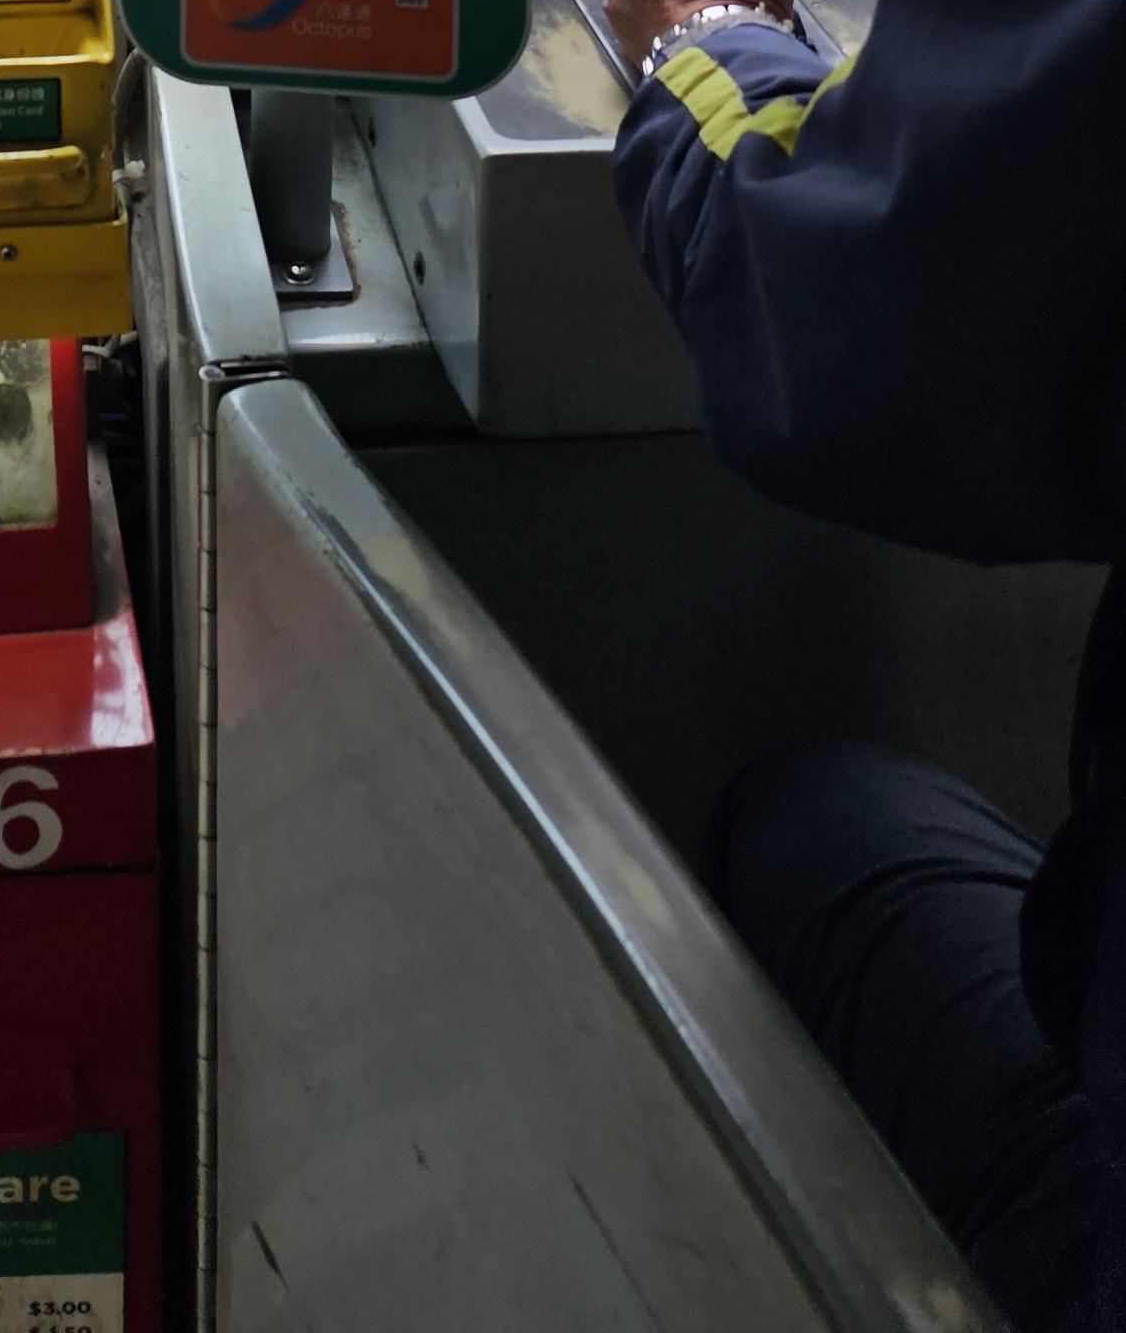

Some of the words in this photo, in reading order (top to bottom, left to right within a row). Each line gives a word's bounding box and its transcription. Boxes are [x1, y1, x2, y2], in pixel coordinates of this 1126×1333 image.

[291, 18, 372, 40] Octopus
[18, 105, 43, 116] Card
[29, 1300, 92, 1317] $3.00
